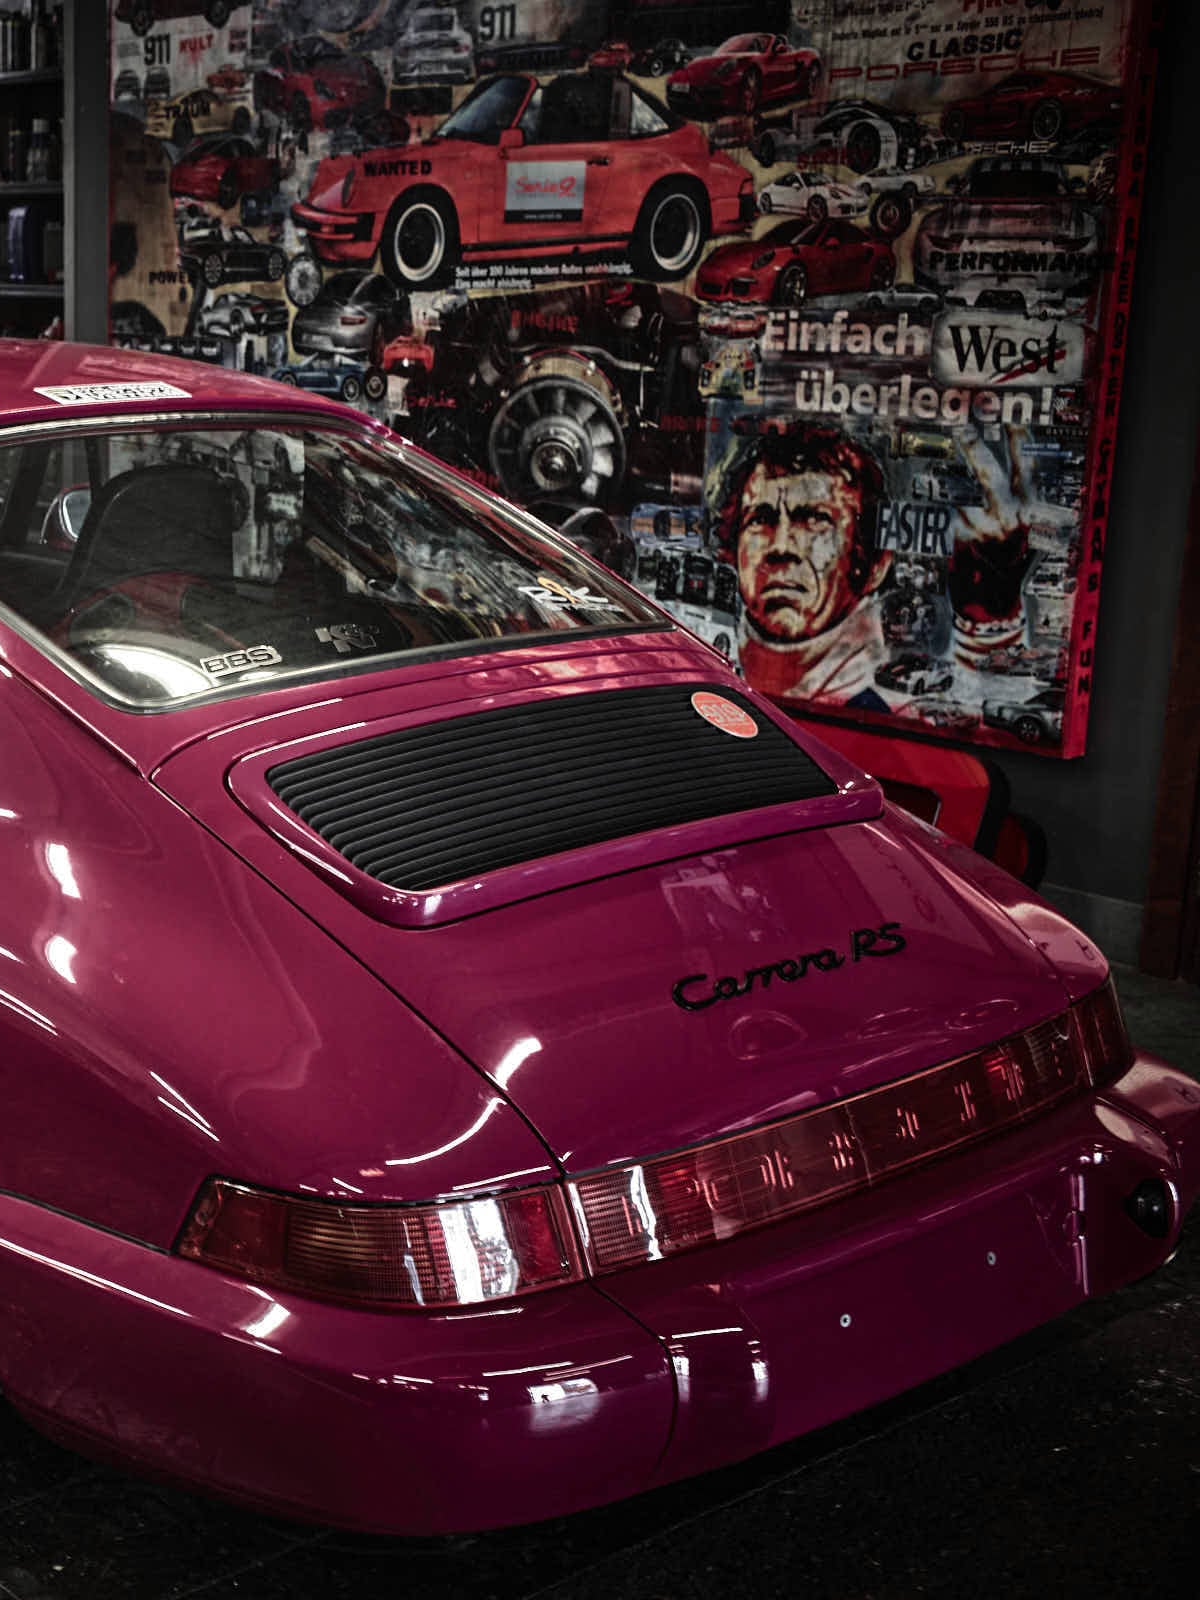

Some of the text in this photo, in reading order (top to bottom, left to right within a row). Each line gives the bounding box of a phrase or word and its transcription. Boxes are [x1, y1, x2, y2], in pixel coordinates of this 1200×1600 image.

[479, 4, 517, 42] 911
[144, 35, 171, 66] 911
[179, 34, 214, 53] KULT
[907, 29, 1022, 61] CLASSIC
[829, 47, 1100, 82] PORSCHE
[364, 160, 432, 177] WANTED
[762, 310, 927, 356] Einfach
[948, 324, 1060, 374] West
[795, 369, 1052, 426] überlegen!
[202, 645, 282, 677] BBS
[1078, 621, 1094, 697] FUN
[673, 922, 906, 1009] Carrera RS
